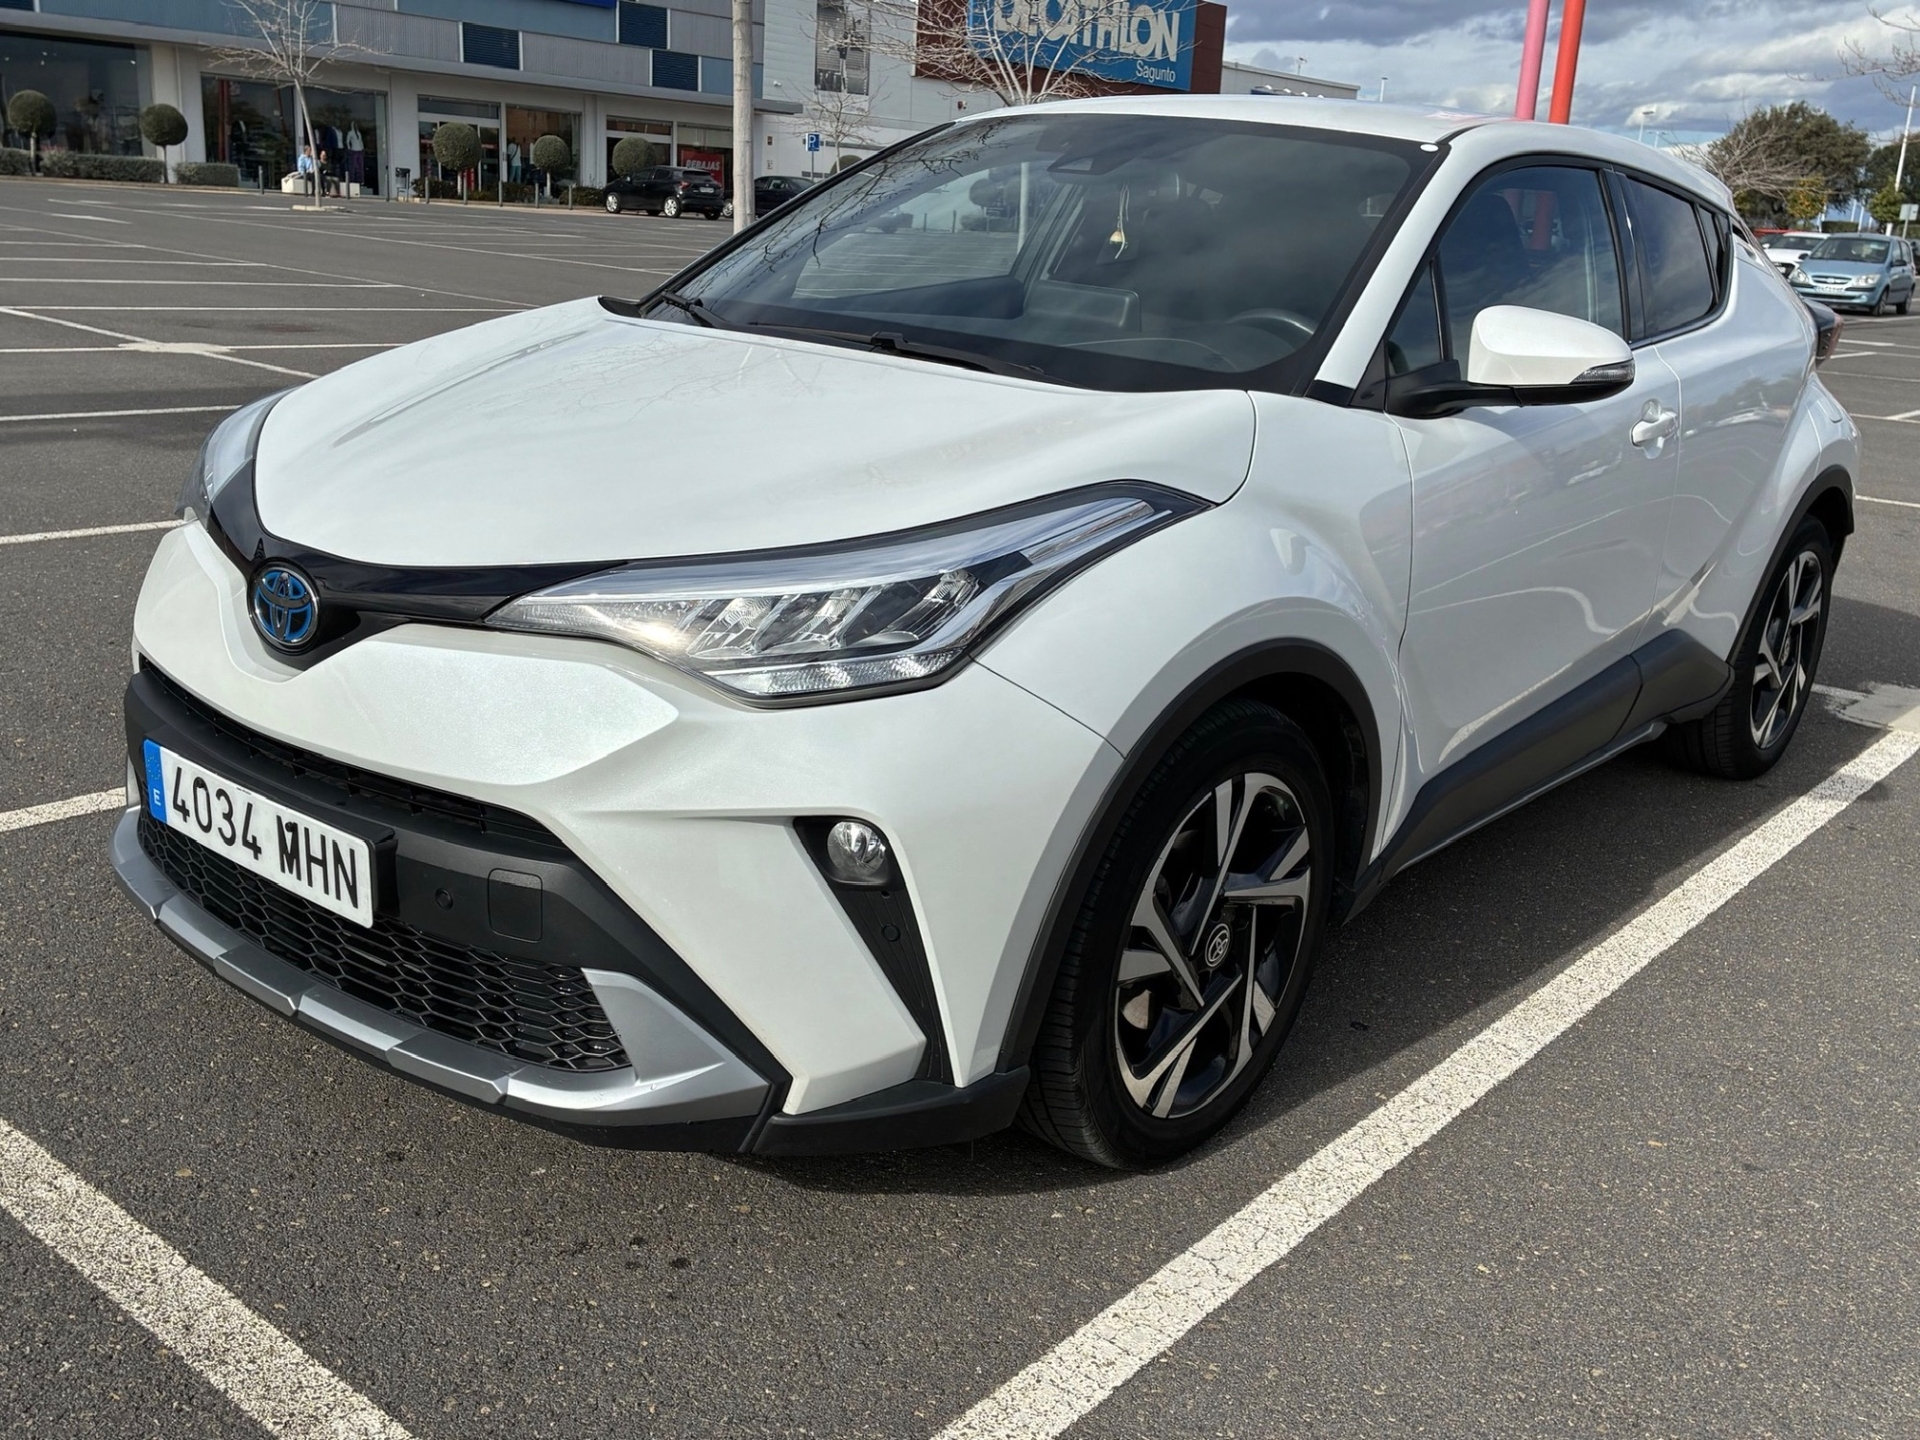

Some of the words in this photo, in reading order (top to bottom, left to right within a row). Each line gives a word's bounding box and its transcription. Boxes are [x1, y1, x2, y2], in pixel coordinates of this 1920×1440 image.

[1136, 60, 1176, 83] Sagunto
[153, 788, 162, 806] E
[172, 766, 262, 861] 4034
[276, 815, 359, 909] MHN
